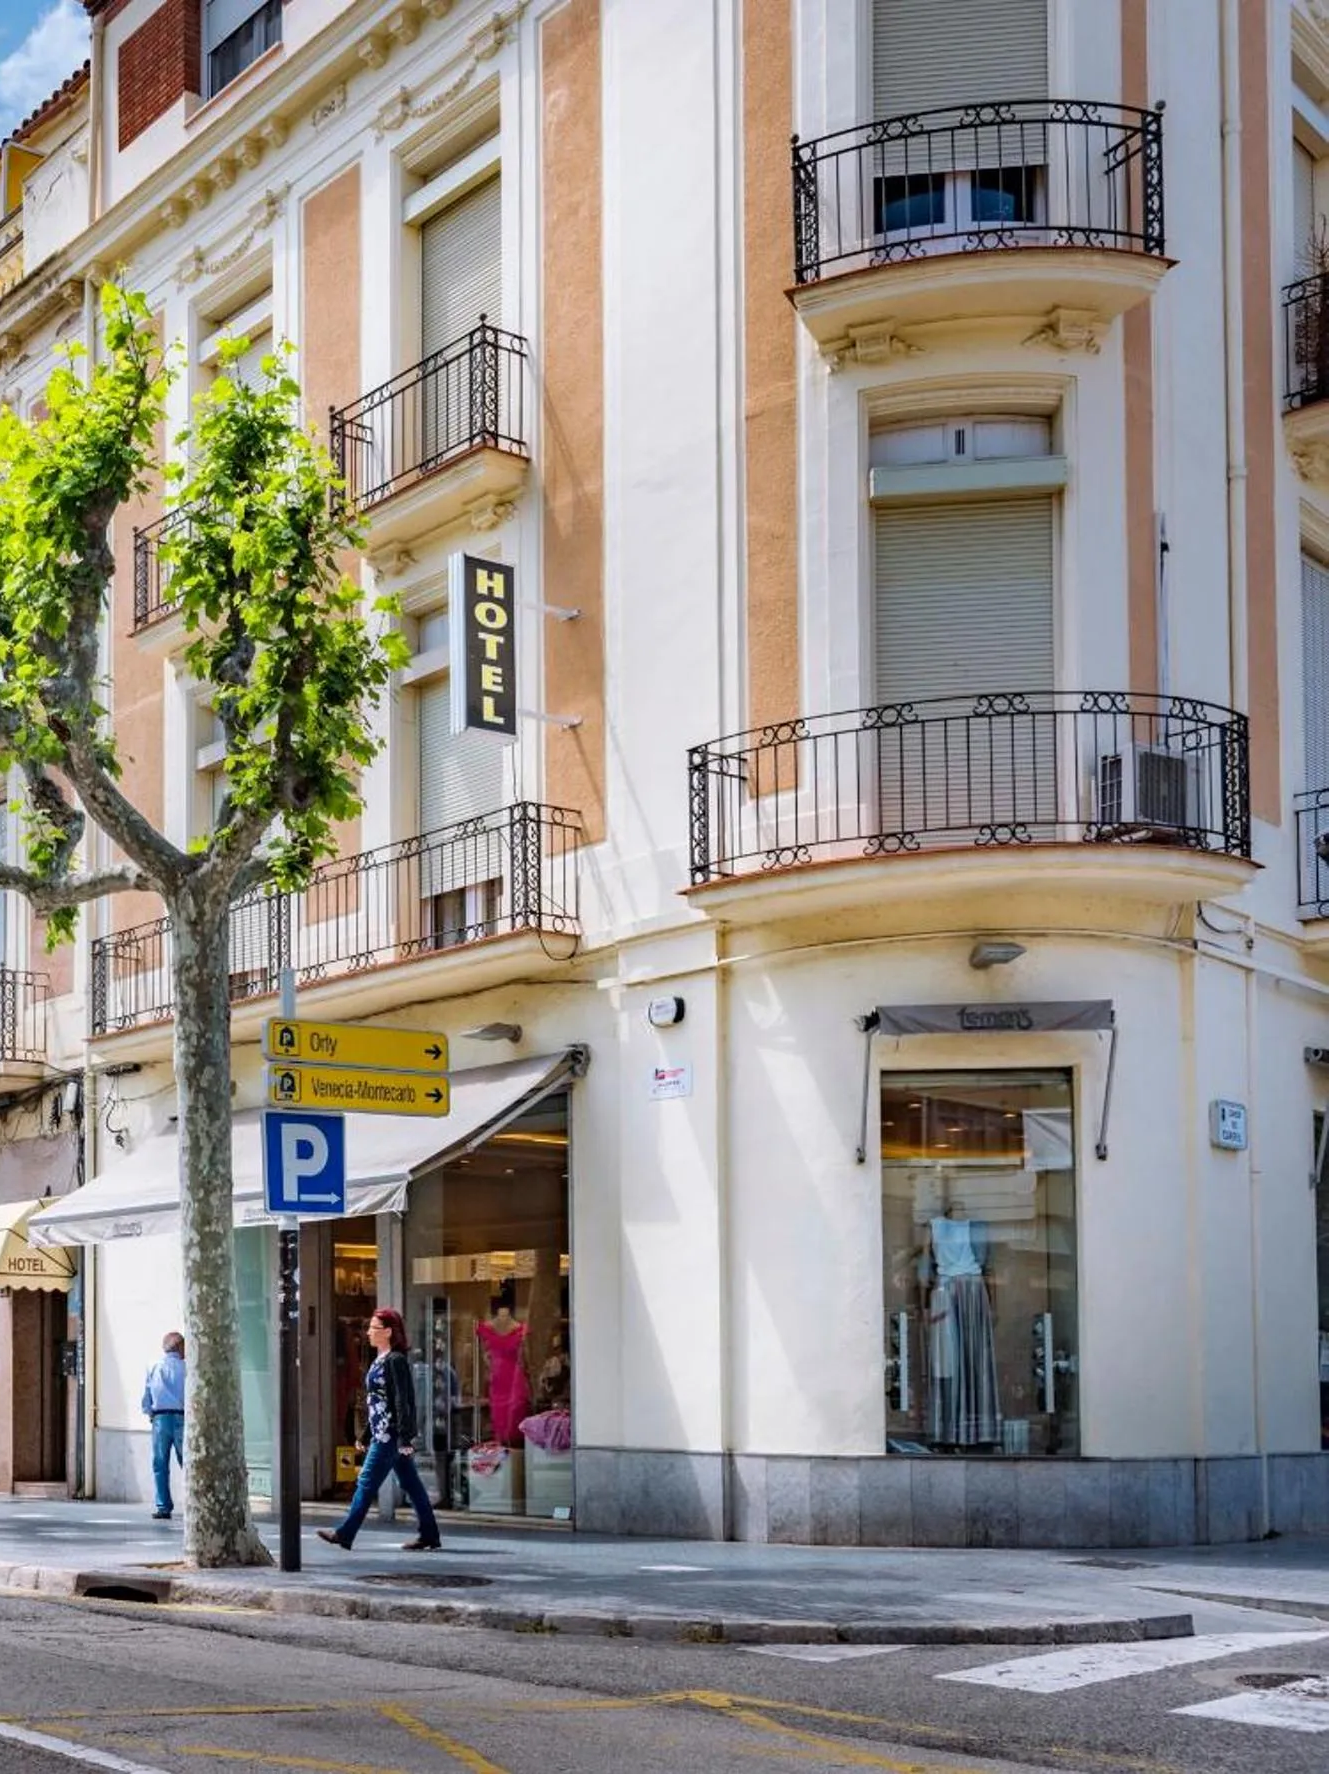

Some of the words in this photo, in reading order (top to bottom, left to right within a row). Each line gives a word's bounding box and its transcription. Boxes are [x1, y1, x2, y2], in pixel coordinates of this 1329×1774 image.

[474, 568, 508, 724] HOTEL
[310, 1032, 338, 1057] Orly
[311, 1076, 416, 1104] Venecia-Montecarlo
[281, 1123, 329, 1202] P
[8, 1257, 47, 1272] HOTEL
